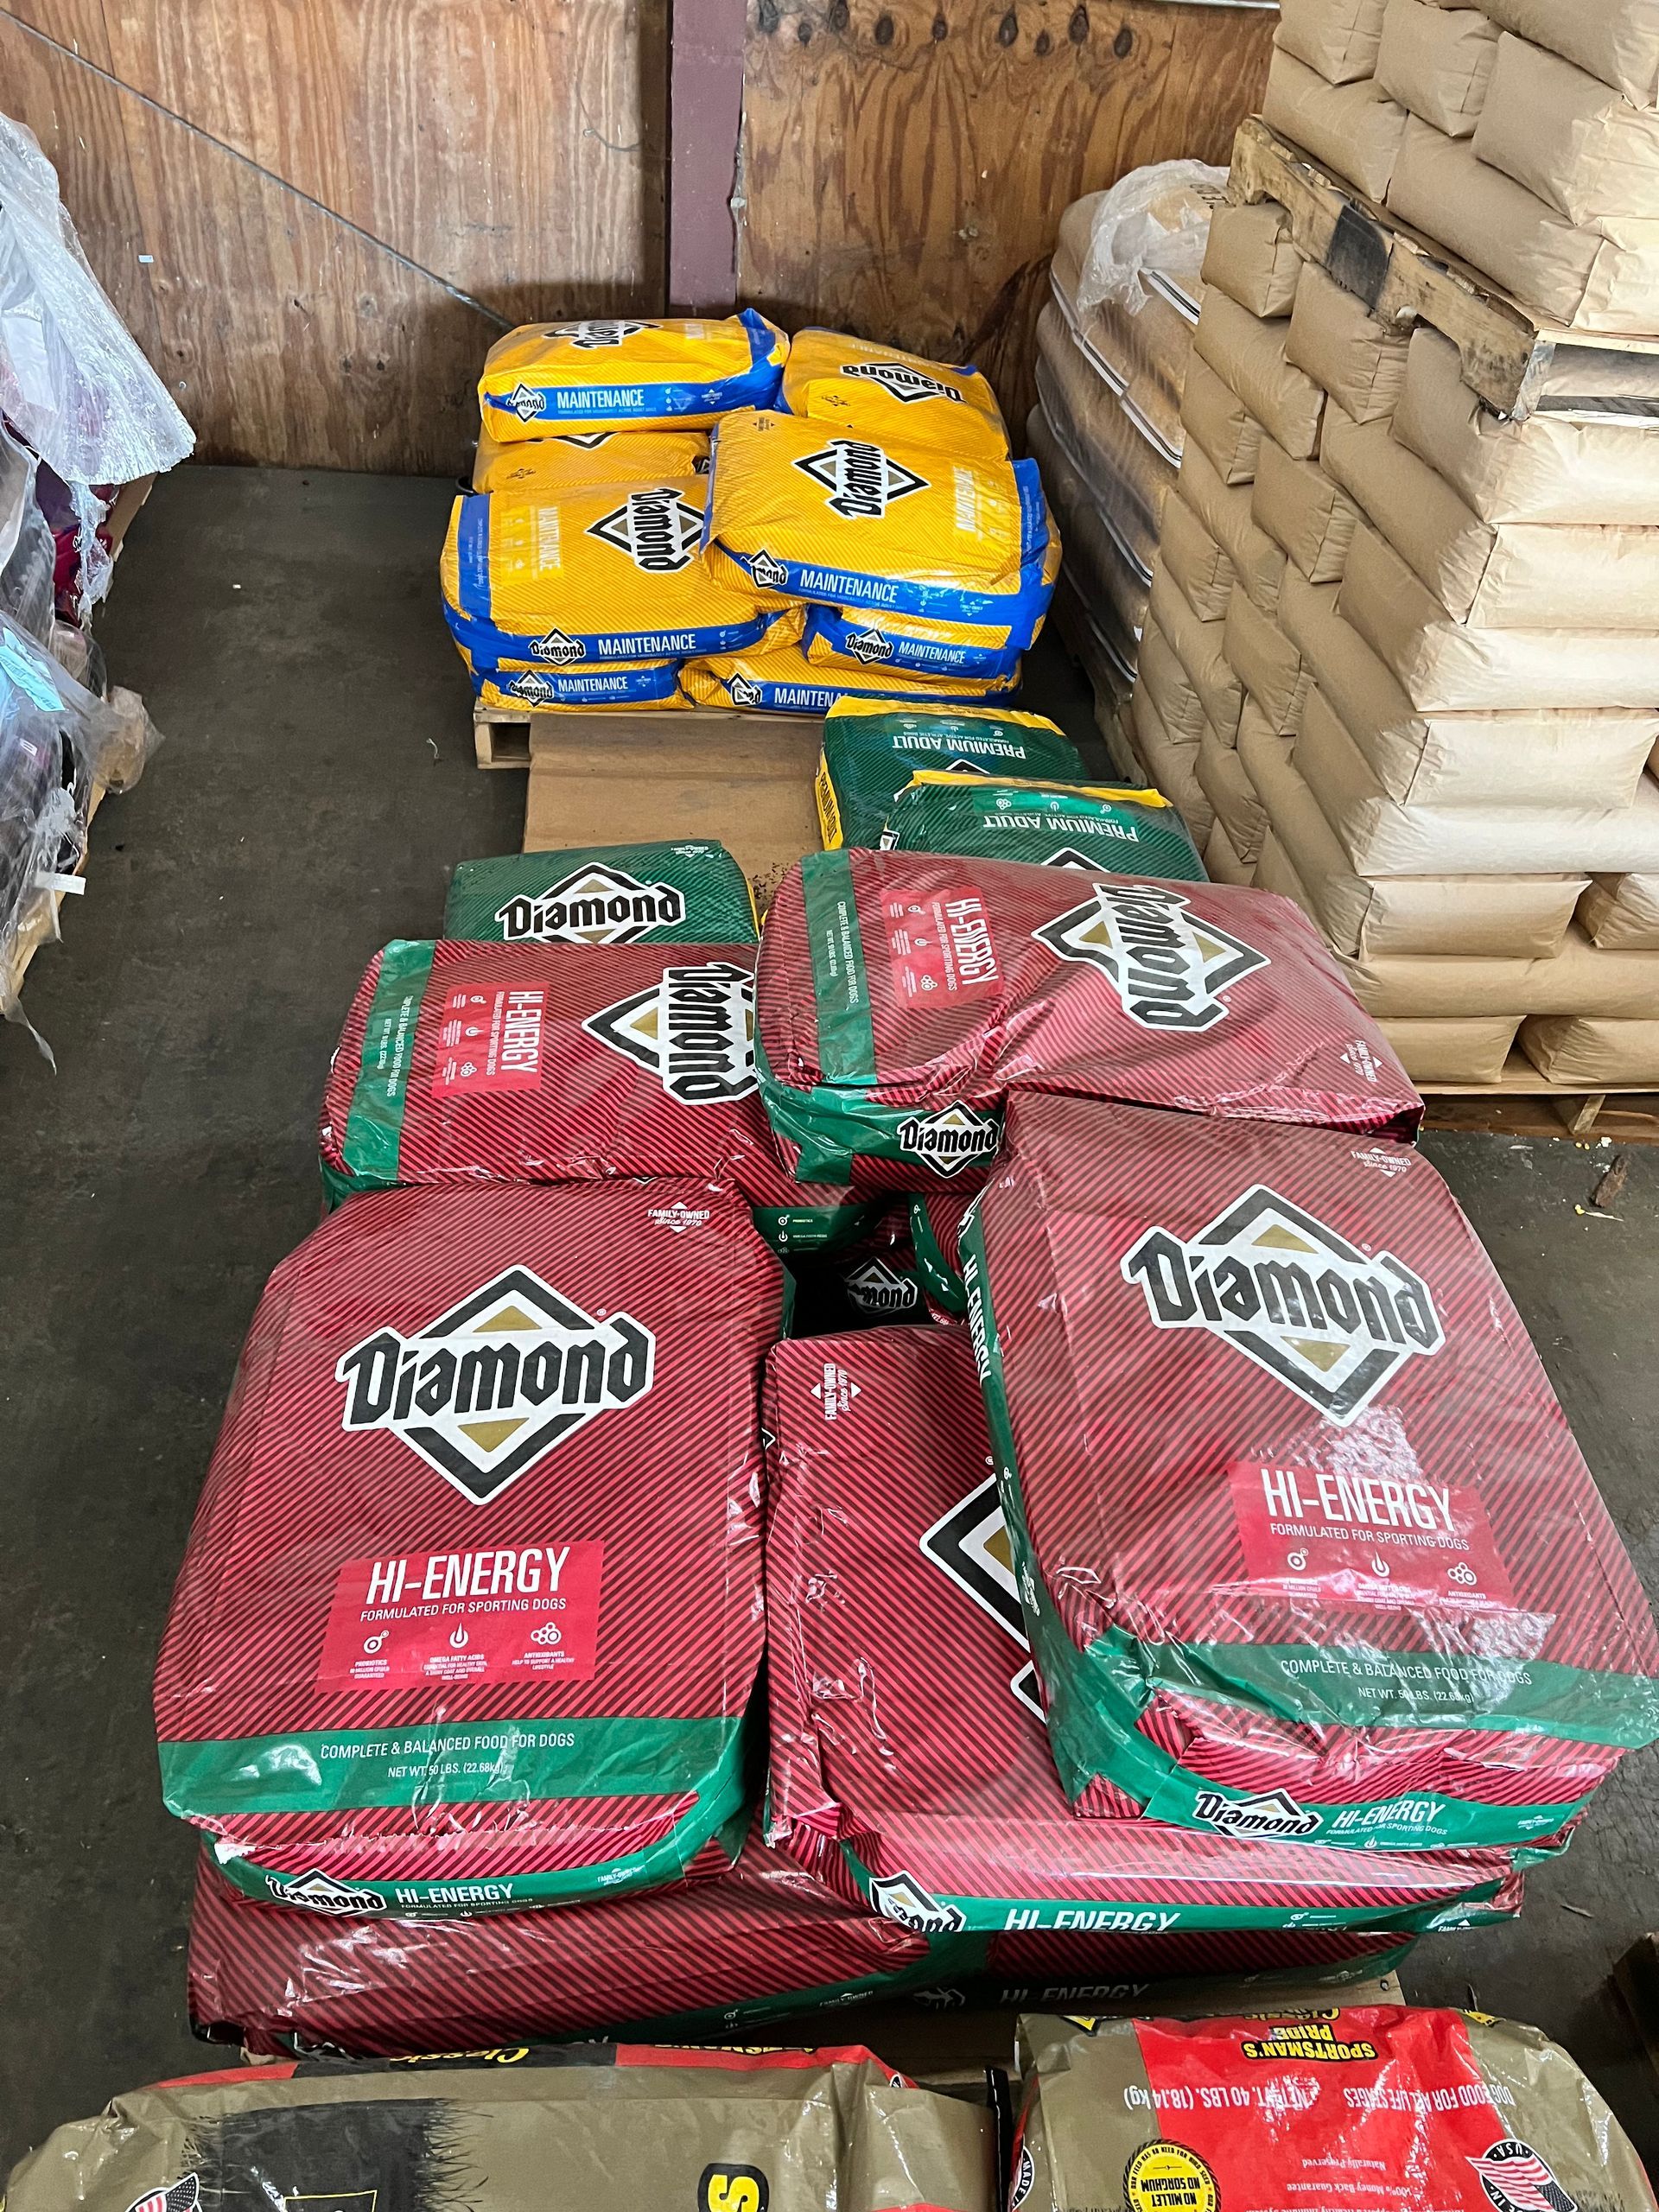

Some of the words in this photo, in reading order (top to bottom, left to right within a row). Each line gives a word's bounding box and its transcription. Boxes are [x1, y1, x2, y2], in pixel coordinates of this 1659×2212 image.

[842, 364, 968, 404] Diamond
[557, 390, 645, 410] MAINTENANCE
[828, 440, 882, 519] Diamond
[632, 488, 692, 571] Diamond
[800, 569, 899, 604] MAINTENANCE
[529, 639, 586, 658] Diamond
[598, 633, 696, 656] MAINTENANCE
[847, 632, 893, 658] Diamond
[899, 642, 965, 664] MAINTENANCE
[557, 677, 628, 692] MAINTENANCE
[892, 735, 942, 750] ADULT
[945, 736, 1027, 760] PREMIUM
[982, 815, 1041, 830] ADULT
[1046, 817, 1140, 842] PREMIUM
[499, 883, 683, 938] Diamond
[939, 935, 949, 945] FOR
[945, 898, 999, 985] HI-ENERGY
[941, 944, 955, 976] SPORTING
[1105, 885, 1224, 1027] Diamond
[849, 985, 860, 1004] DOGS
[947, 976, 958, 992] DOGS
[491, 1020, 500, 1031] FOR
[500, 990, 544, 1074] HI-ENERGY
[666, 963, 759, 1101] Diamond
[488, 1031, 500, 1058] SPORTING
[486, 1058, 497, 1076] DOGS
[1355, 1040, 1376, 1082] FAMILY-OWNED
[386, 1078, 397, 1097] DOGS
[899, 1118, 1000, 1153] Diamond
[1350, 1150, 1412, 1166] FAMILY-OWNED
[1363, 1160, 1389, 1170] Since
[1389, 1164, 1408, 1173] 1970
[647, 1209, 710, 1220] FAMILY-OWNED
[654, 1217, 681, 1225] Since
[1128, 1231, 1440, 1349] Diamond
[344, 1317, 647, 1426] Diamond
[837, 1369, 849, 1385] 1970
[823, 1363, 837, 1421] FAMILY-OWNED
[837, 1384, 852, 1412] Since
[1261, 1468, 1456, 1531] HI-ENERGY
[1270, 1523, 1350, 1541] FORMULATED
[1351, 1530, 1375, 1542] FOR
[1377, 1531, 1435, 1548] SPORTING
[1435, 1537, 1470, 1551] DOGS
[365, 1546, 571, 1605] HI-ENERGY
[359, 1605, 440, 1622] FORMULATED
[442, 1602, 465, 1615] FOR
[467, 1599, 529, 1614] SPORTING
[532, 1599, 567, 1611] DOGS
[1281, 1660, 1350, 1675] COMPLETE
[1352, 1663, 1363, 1675] &
[1366, 1663, 1432, 1680] BALANCED
[1434, 1667, 1468, 1681] FOOD
[1471, 1669, 1494, 1682] FOR
[1497, 1672, 1532, 1685] DOGS
[1358, 1687, 1376, 1698] NET
[1378, 1688, 1397, 1700] WT.
[1412, 1690, 1433, 1700] LBS.
[321, 1742, 389, 1759] COMPLETE
[391, 1741, 401, 1755] &
[404, 1737, 471, 1754] BALANCED
[474, 1735, 508, 1750] FOOD
[512, 1733, 537, 1748] FOR
[539, 1732, 575, 1747] DOGS
[388, 1766, 407, 1778] NET
[410, 1765, 428, 1777] WT.
[429, 1764, 439, 1776] 50
[441, 1764, 461, 1775] LBS.
[1198, 1792, 1319, 1834] Diamond
[1332, 1800, 1446, 1829] HI-ENERGY
[1325, 1826, 1374, 1835] FORMULATED
[1386, 1822, 1425, 1833] SPORTING
[1425, 1826, 1448, 1835] DOGS
[395, 1883, 513, 1904] HI-ENERGY
[470, 1899, 511, 1908] SPORTING
[1004, 1908, 1182, 1932] HI-ENERGY
[1271, 2024, 1335, 2041] PRIDE
[1243, 2040, 1376, 2061] SPORTSMAN'S
[1123, 2085, 1152, 2111] kg)
[1152, 2085, 1195, 2110] (18.14
[1195, 2086, 1230, 2108] LBS.
[1230, 2086, 1250, 2106] 40
[1343, 2087, 1389, 2109] STAGES
[1387, 2089, 1410, 2110] LIFE
[1431, 2088, 1457, 2109] FOR
[1458, 2082, 1491, 2108] FOOD
[1491, 2082, 1516, 2107] DOG
[1496, 2143, 1523, 2158] USA
[1302, 2156, 1346, 2170] Preserved
[1347, 2158, 1387, 2171] Naturally
[1018, 2160, 1033, 2196] MADE
[1140, 2177, 1187, 2193] SORGHUM
[1187, 2177, 1201, 2190] NO
[1286, 2182, 1333, 2193] Guarantee
[1334, 2183, 1356, 2193] Back
[1356, 2181, 1384, 2195] Money
[1151, 2193, 1184, 2208] MILLET
[1184, 2192, 1198, 2205] NO
[1491, 2190, 1506, 2208] IN
